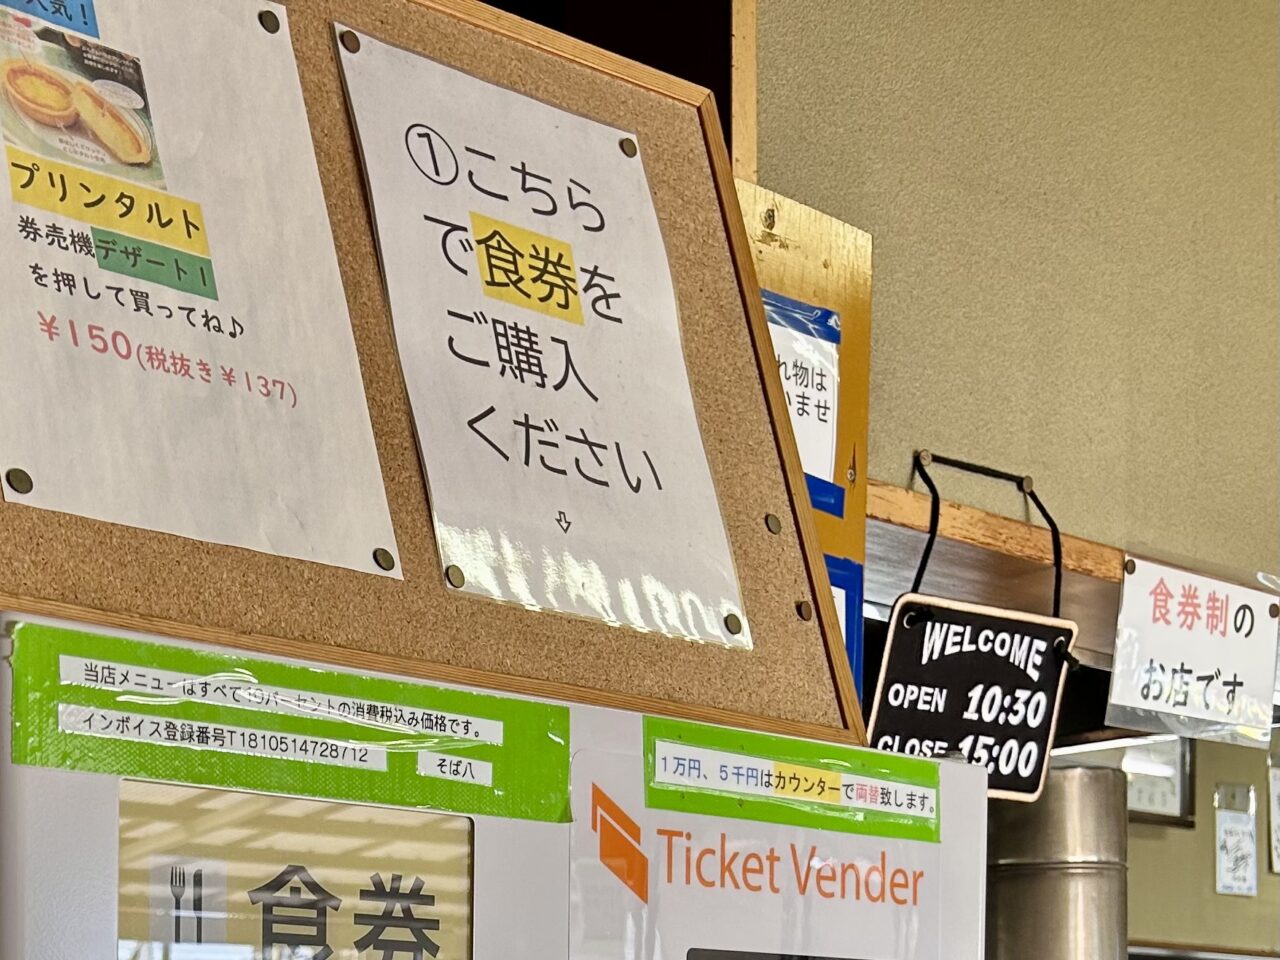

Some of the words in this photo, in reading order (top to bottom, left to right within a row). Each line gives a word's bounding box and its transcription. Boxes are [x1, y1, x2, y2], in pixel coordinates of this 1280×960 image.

[11, 160, 201, 241] プリンタルト
[423, 214, 623, 324] で食券を
[446, 309, 599, 402] ご購入
[466, 405, 663, 493] ください
[1149, 577, 1254, 638] 食券制の
[921, 621, 1048, 682] WELCOME
[1141, 658, 1244, 715] お店です
[888, 683, 947, 713] OPEN
[963, 684, 1047, 728] 10:30
[959, 734, 1038, 777] 15:00
[656, 827, 781, 895] Ticket
[790, 843, 925, 906] Vender
